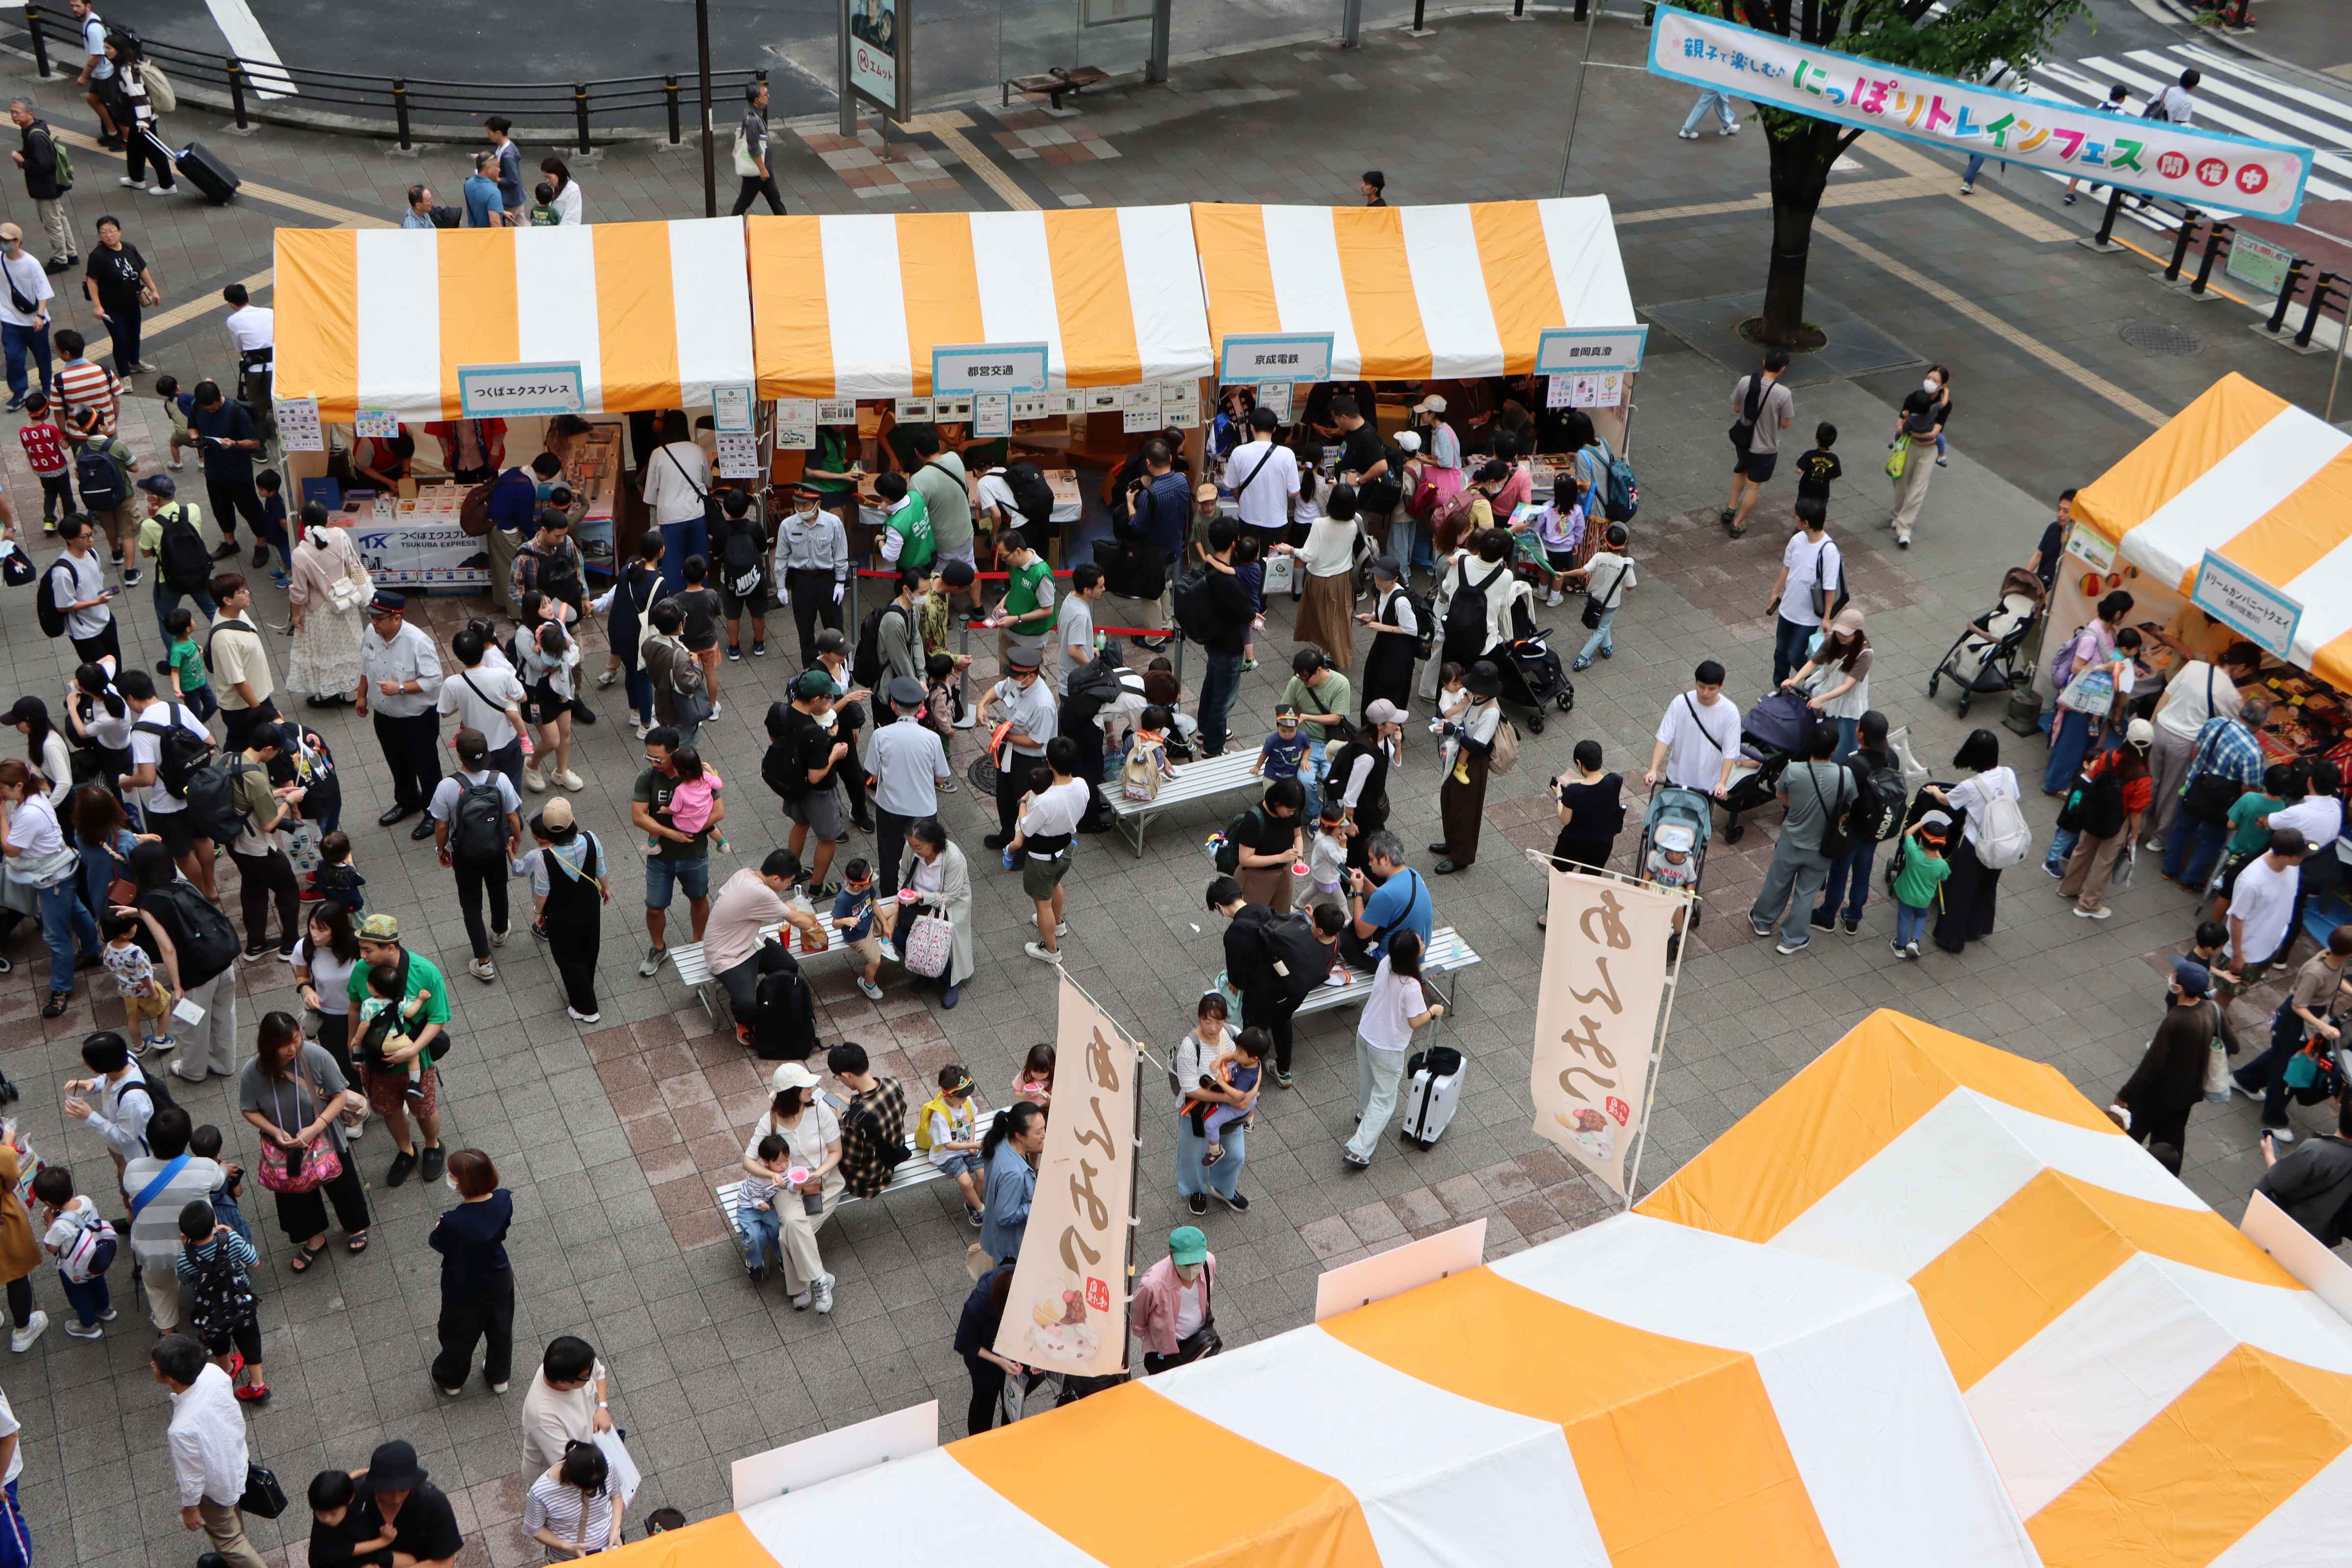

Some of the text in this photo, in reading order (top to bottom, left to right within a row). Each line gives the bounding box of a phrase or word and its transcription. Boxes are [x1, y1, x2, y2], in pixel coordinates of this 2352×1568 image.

[870, 61, 893, 82] エムット
[1791, 58, 2146, 174] にっぽりトレインフェス
[2158, 152, 2267, 193] 開催中
[1569, 345, 1613, 358] 豊岡真澄
[1254, 353, 1300, 365] 京成電鉄
[966, 364, 1014, 377] 都営交通
[474, 384, 570, 397] つくばエクスプレス
[26, 442, 54, 454] KEY
[32, 454, 59, 466] BOY
[358, 532, 395, 549] TX
[736, 564, 761, 592] NIKE
